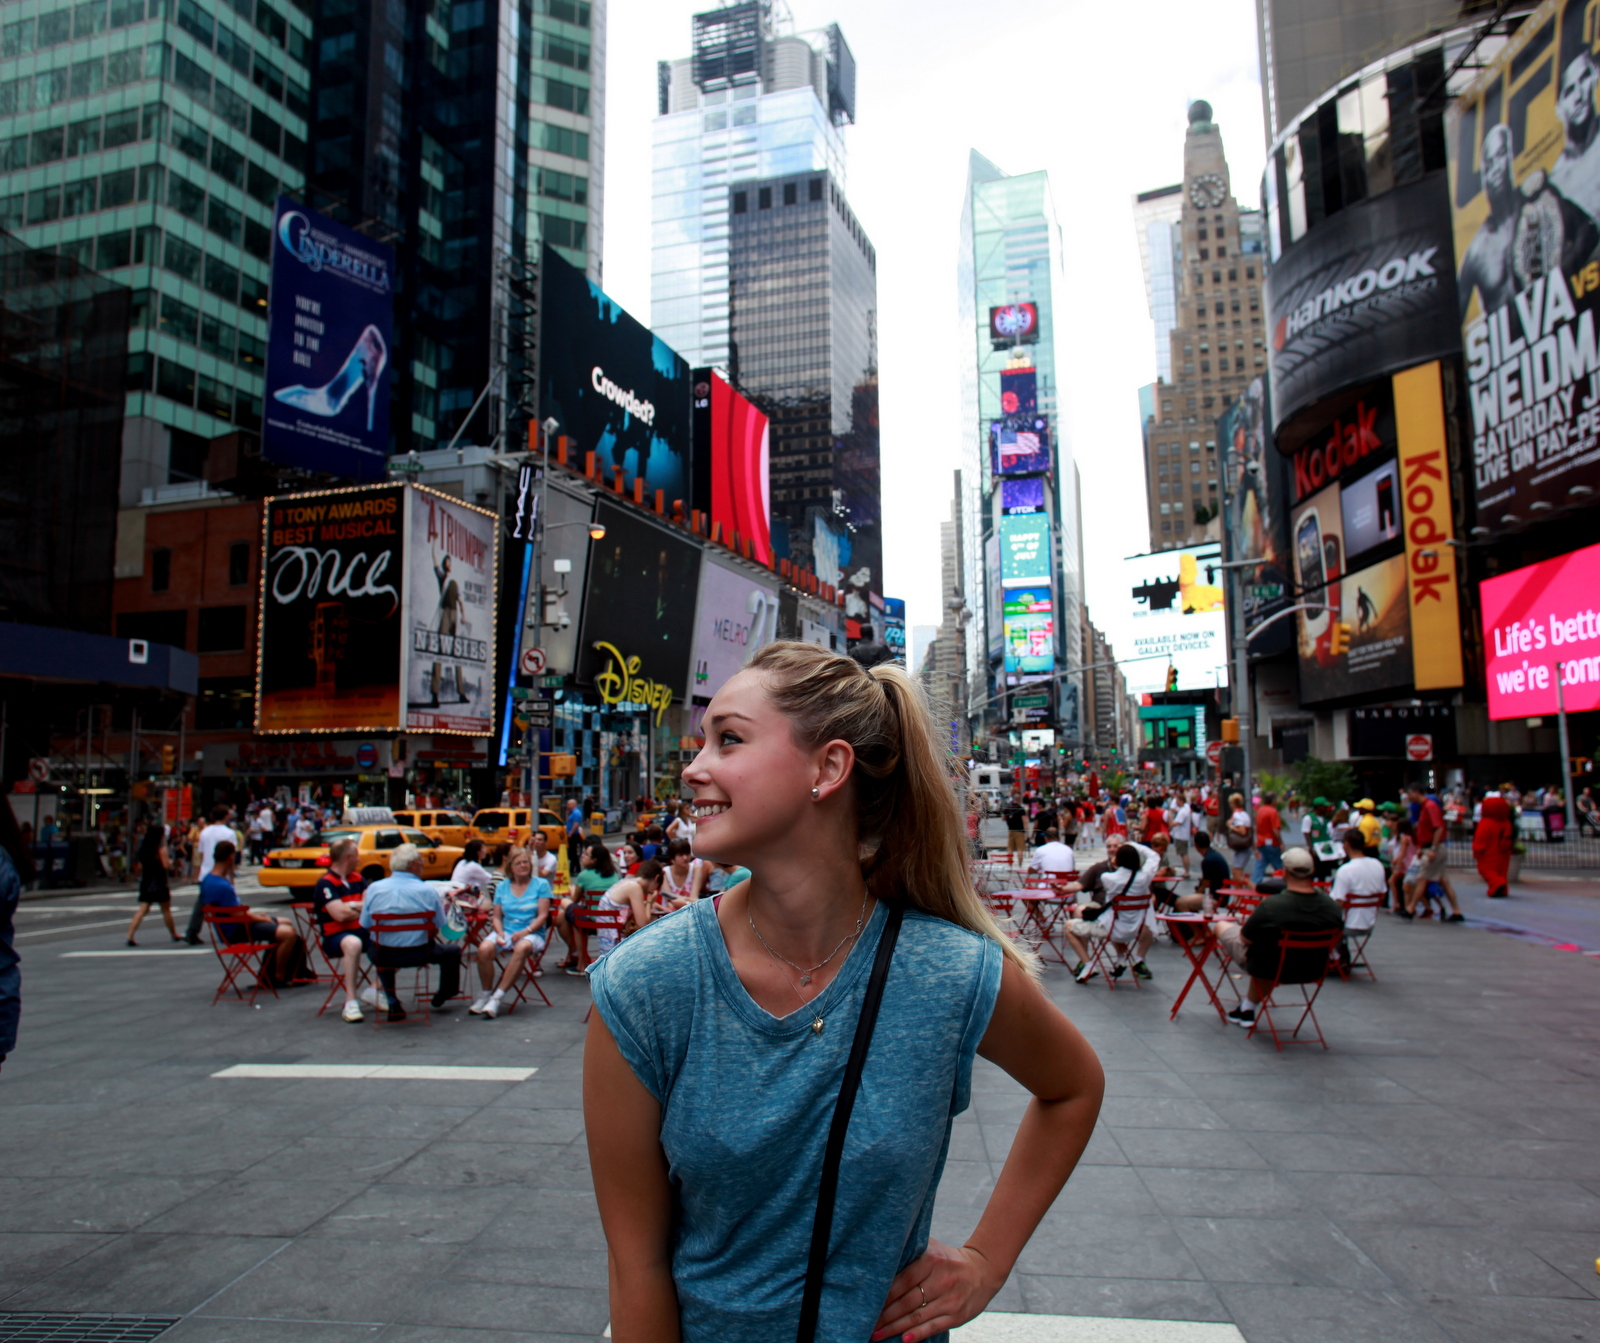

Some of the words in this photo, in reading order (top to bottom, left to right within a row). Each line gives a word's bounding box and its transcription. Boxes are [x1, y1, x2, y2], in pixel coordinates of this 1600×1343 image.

[1570, 261, 1600, 299] VS
[1466, 265, 1577, 383] SILVA
[1468, 308, 1600, 436] WEIDM
[592, 366, 655, 426] Crowded?
[695, 398, 708, 409] LG
[1473, 384, 1576, 466] SATURDAY
[1582, 369, 1600, 410] J
[1293, 401, 1383, 500] Kodak
[1475, 453, 1510, 490] LIVE
[1511, 440, 1535, 472] ON
[286, 503, 330, 525] TONY
[328, 496, 397, 520] AWARDS
[272, 526, 317, 546] BEST
[320, 517, 397, 542] MUSICAL
[1010, 533, 1040, 542] HAPPY
[1404, 450, 1451, 605] Kodak
[1014, 551, 1037, 560] JULY
[1026, 542, 1039, 550] OF
[415, 629, 486, 661] NEWSIES
[713, 616, 750, 646] MELRO
[1134, 634, 1177, 646] AVAILABLE
[1180, 632, 1199, 641] NOW
[1202, 630, 1215, 638] ON
[1494, 618, 1546, 657] Life's
[1138, 645, 1171, 655] GALAXY
[696, 660, 708, 686] LA
[1496, 660, 1549, 694] we're
[1355, 706, 1450, 719] MARQUIS
[239, 741, 337, 758] DIGITAL
